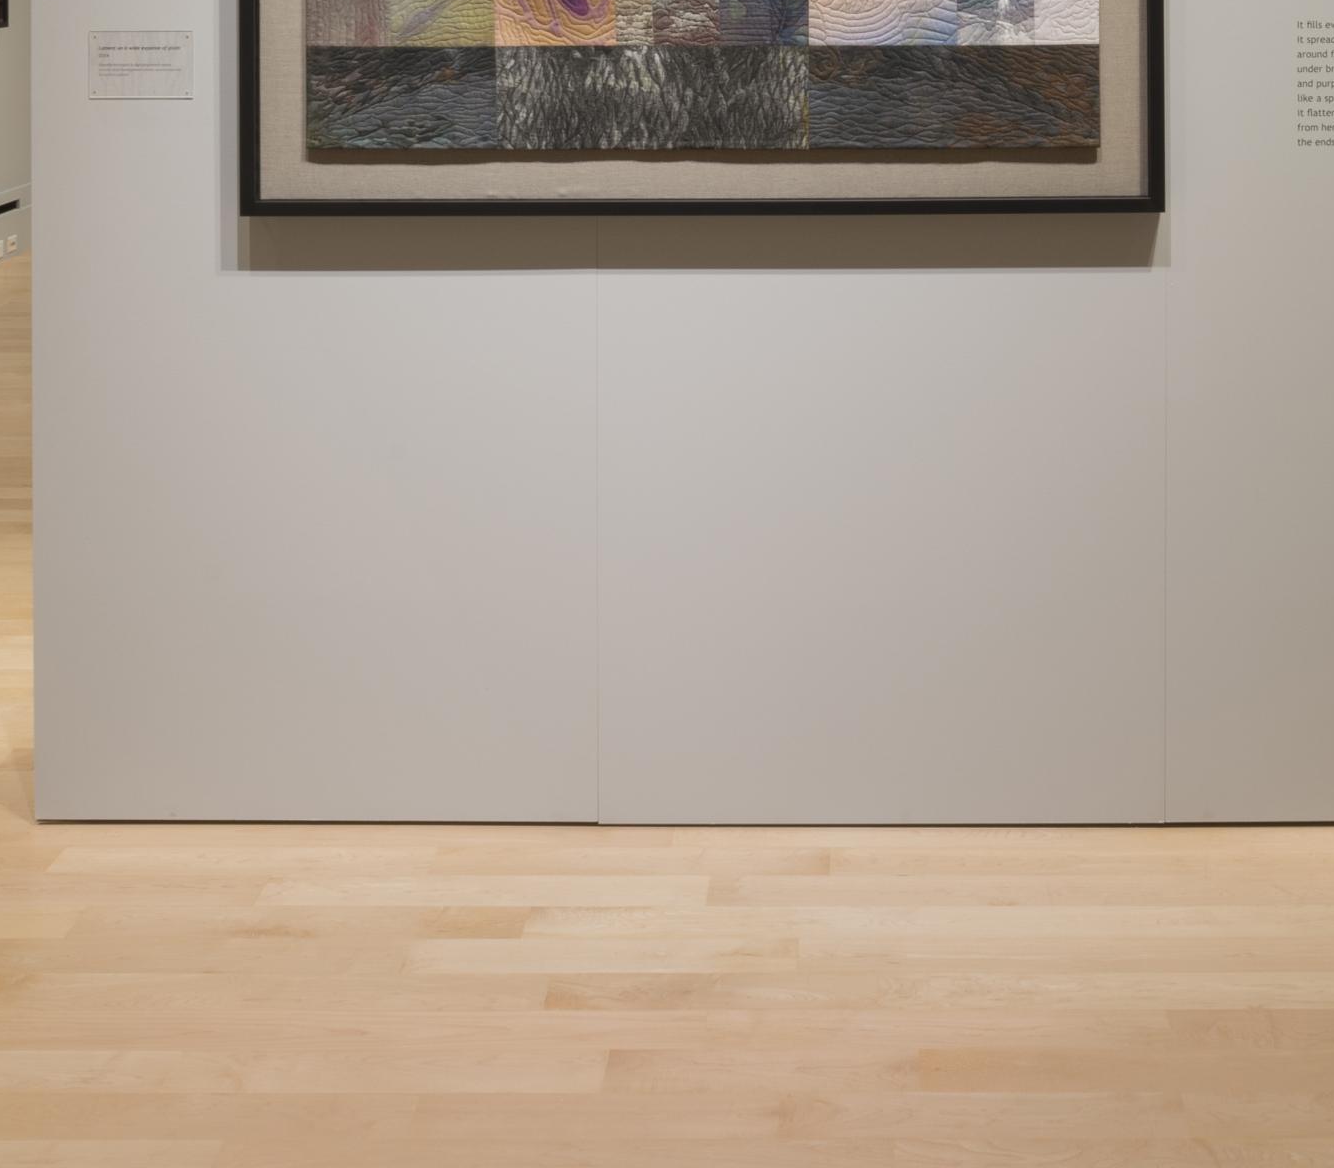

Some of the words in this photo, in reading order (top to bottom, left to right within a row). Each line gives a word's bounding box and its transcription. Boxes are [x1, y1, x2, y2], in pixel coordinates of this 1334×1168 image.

[1297, 20, 1304, 29] It
[1306, 20, 1323, 29] fills
[1297, 49, 1328, 58] around
[1297, 64, 1324, 73] under
[1297, 79, 1314, 87] and
[1297, 93, 1314, 102] like
[1297, 122, 1319, 131] from
[1297, 137, 1313, 146] the
